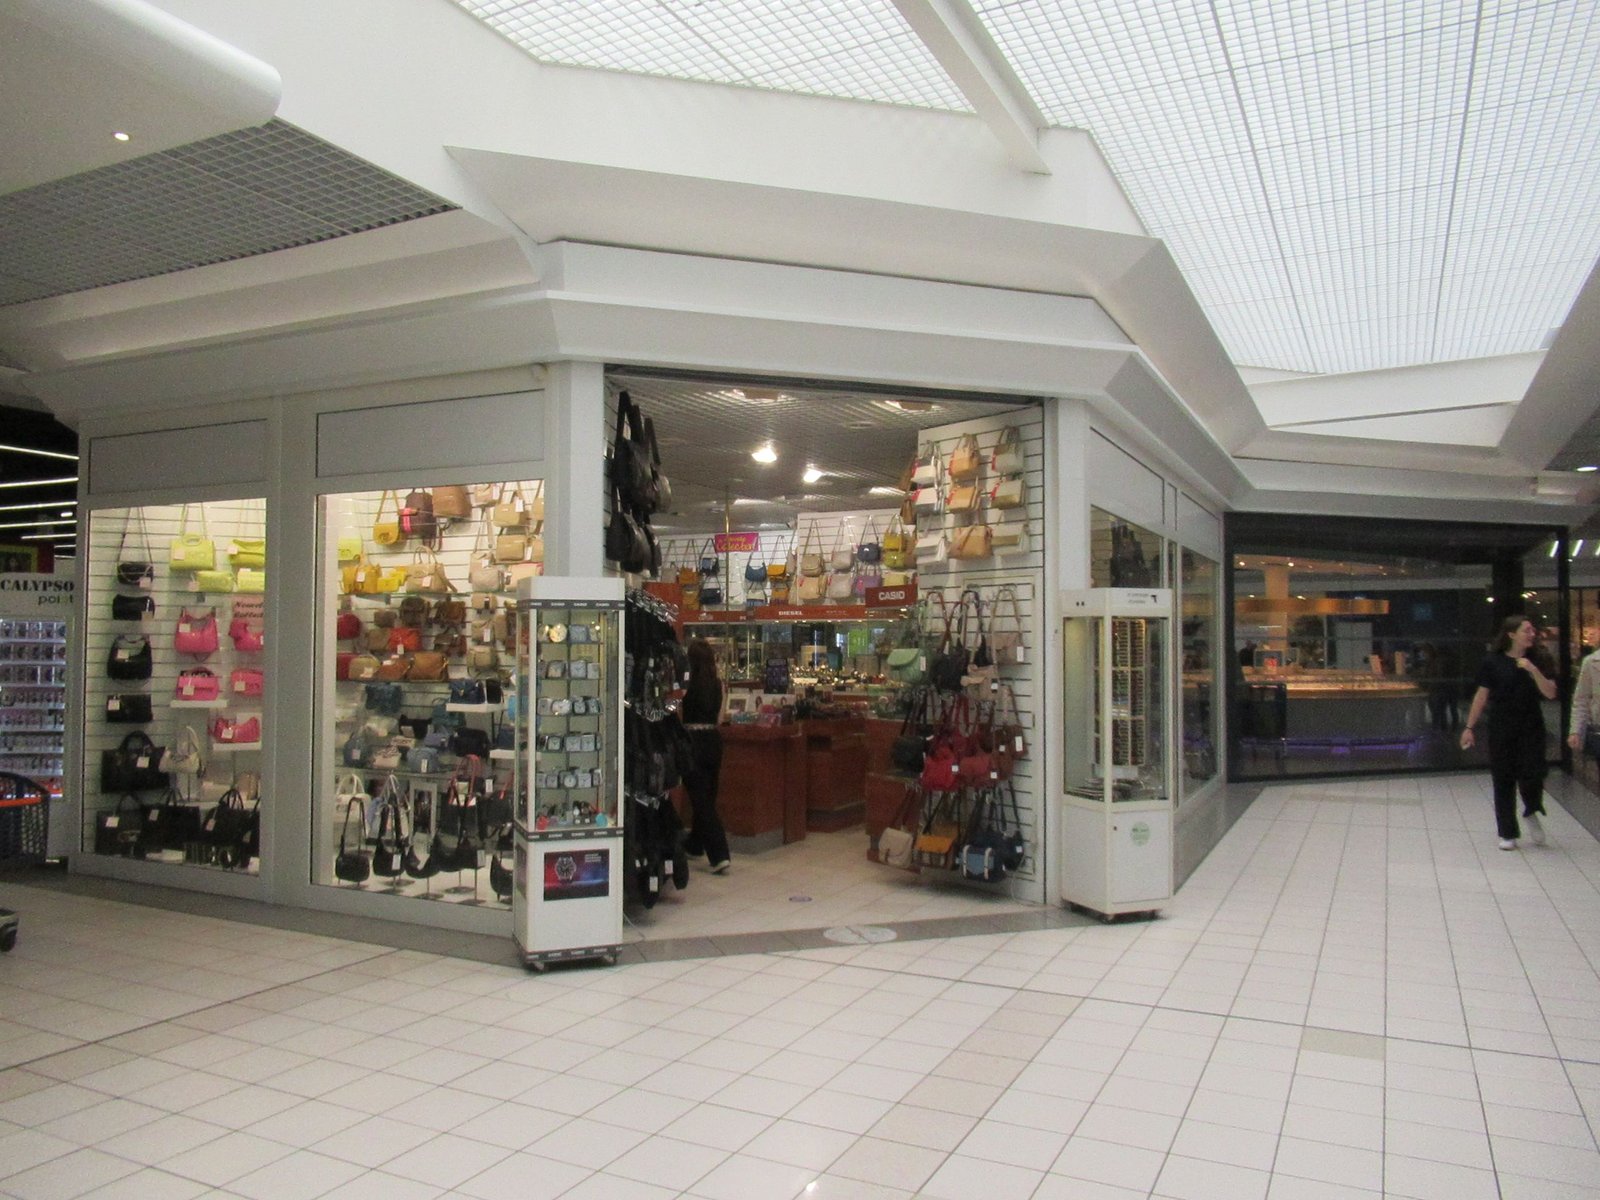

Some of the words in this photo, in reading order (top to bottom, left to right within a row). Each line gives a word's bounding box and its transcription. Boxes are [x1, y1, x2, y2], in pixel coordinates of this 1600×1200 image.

[0, 580, 75, 592] CALYPSO
[38, 594, 73, 605] poit
[878, 590, 905, 601] CASIO
